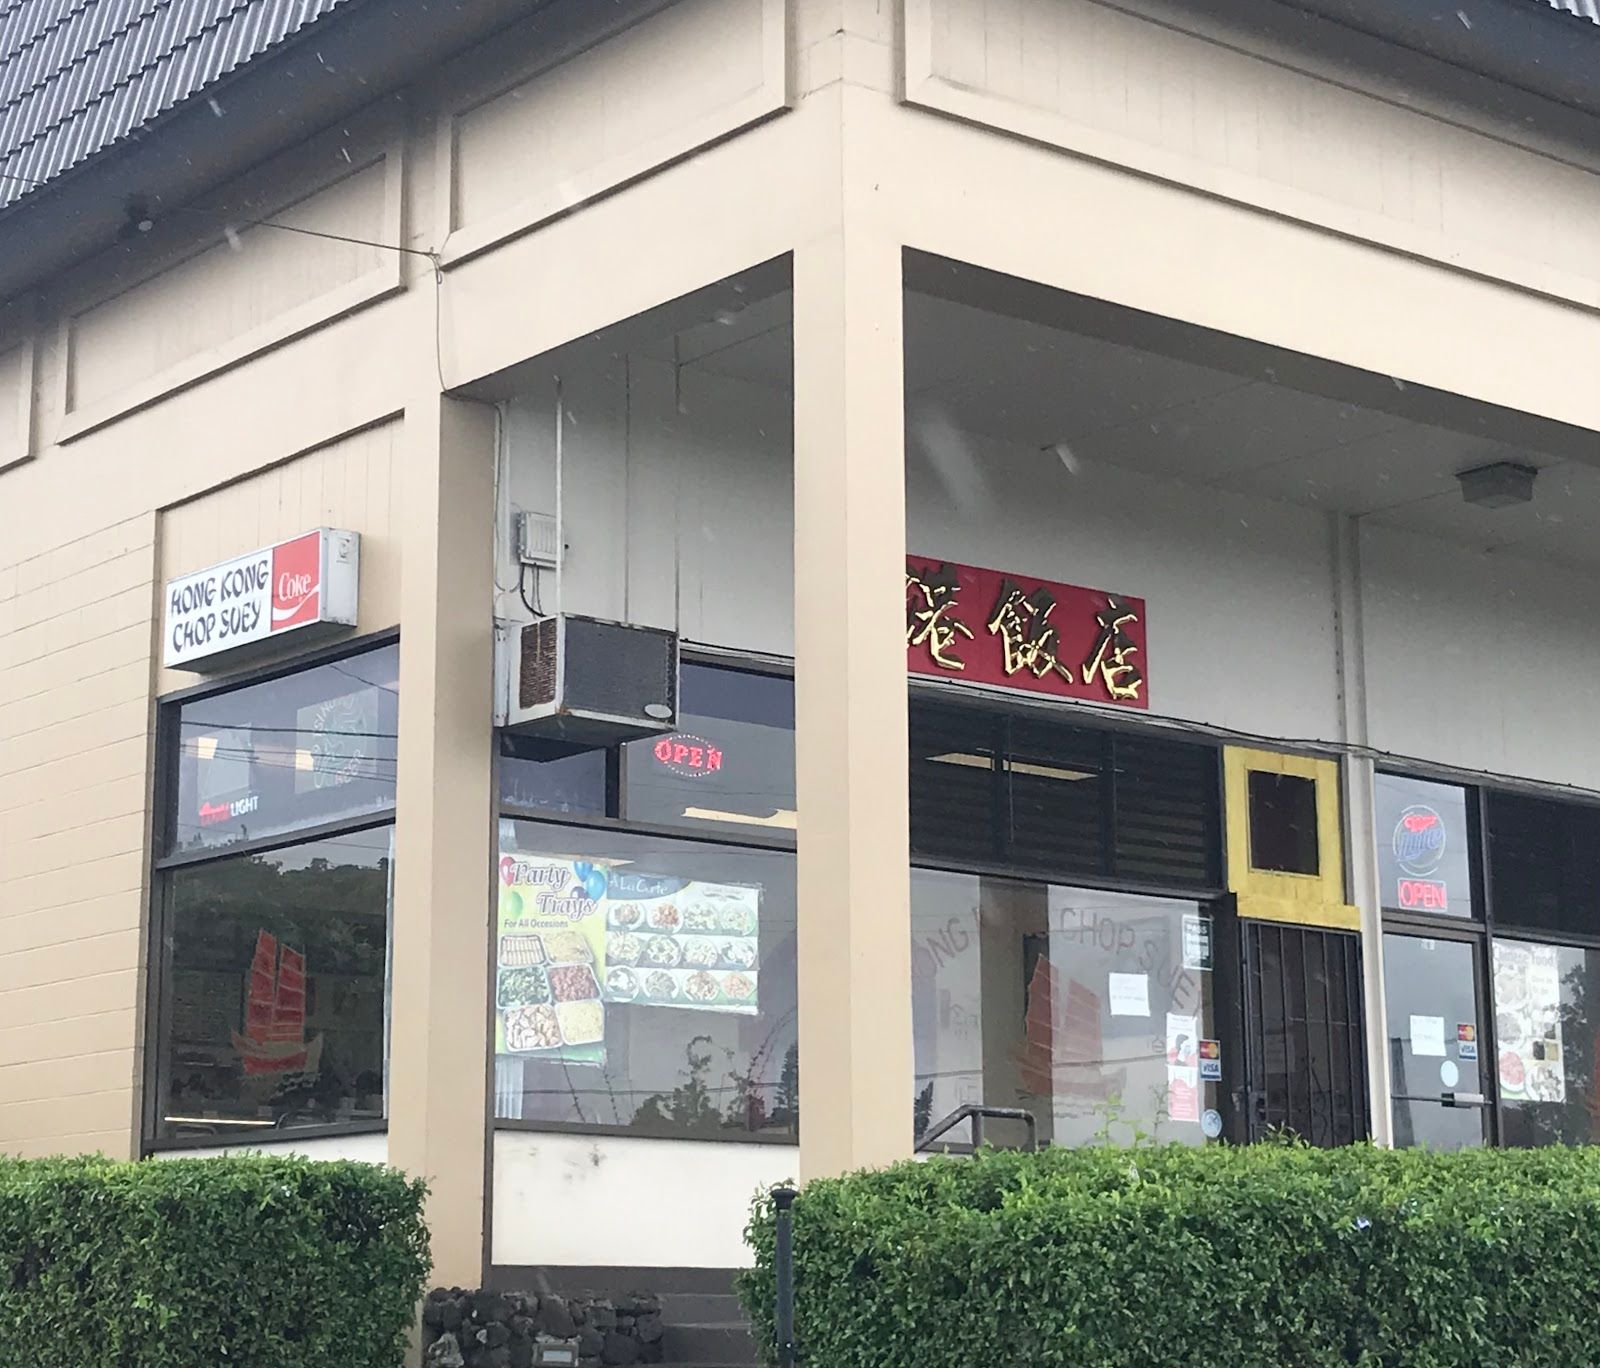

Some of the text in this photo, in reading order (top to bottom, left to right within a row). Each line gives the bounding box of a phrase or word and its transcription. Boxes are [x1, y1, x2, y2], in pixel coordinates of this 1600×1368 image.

[171, 560, 269, 616] HONG KONG
[279, 572, 311, 601] Coke
[172, 601, 262, 653] CHOP SUEY
[654, 740, 723, 770] OPEN
[230, 796, 259, 817] LIGHT
[510, 861, 571, 892] Party
[536, 891, 597, 923] Trays
[1400, 881, 1446, 908] OPEN
[504, 918, 517, 928] For
[518, 918, 529, 928] All
[1060, 908, 1136, 955] CHOP
[911, 917, 969, 983] ONG
[1203, 1062, 1219, 1073] VISA
